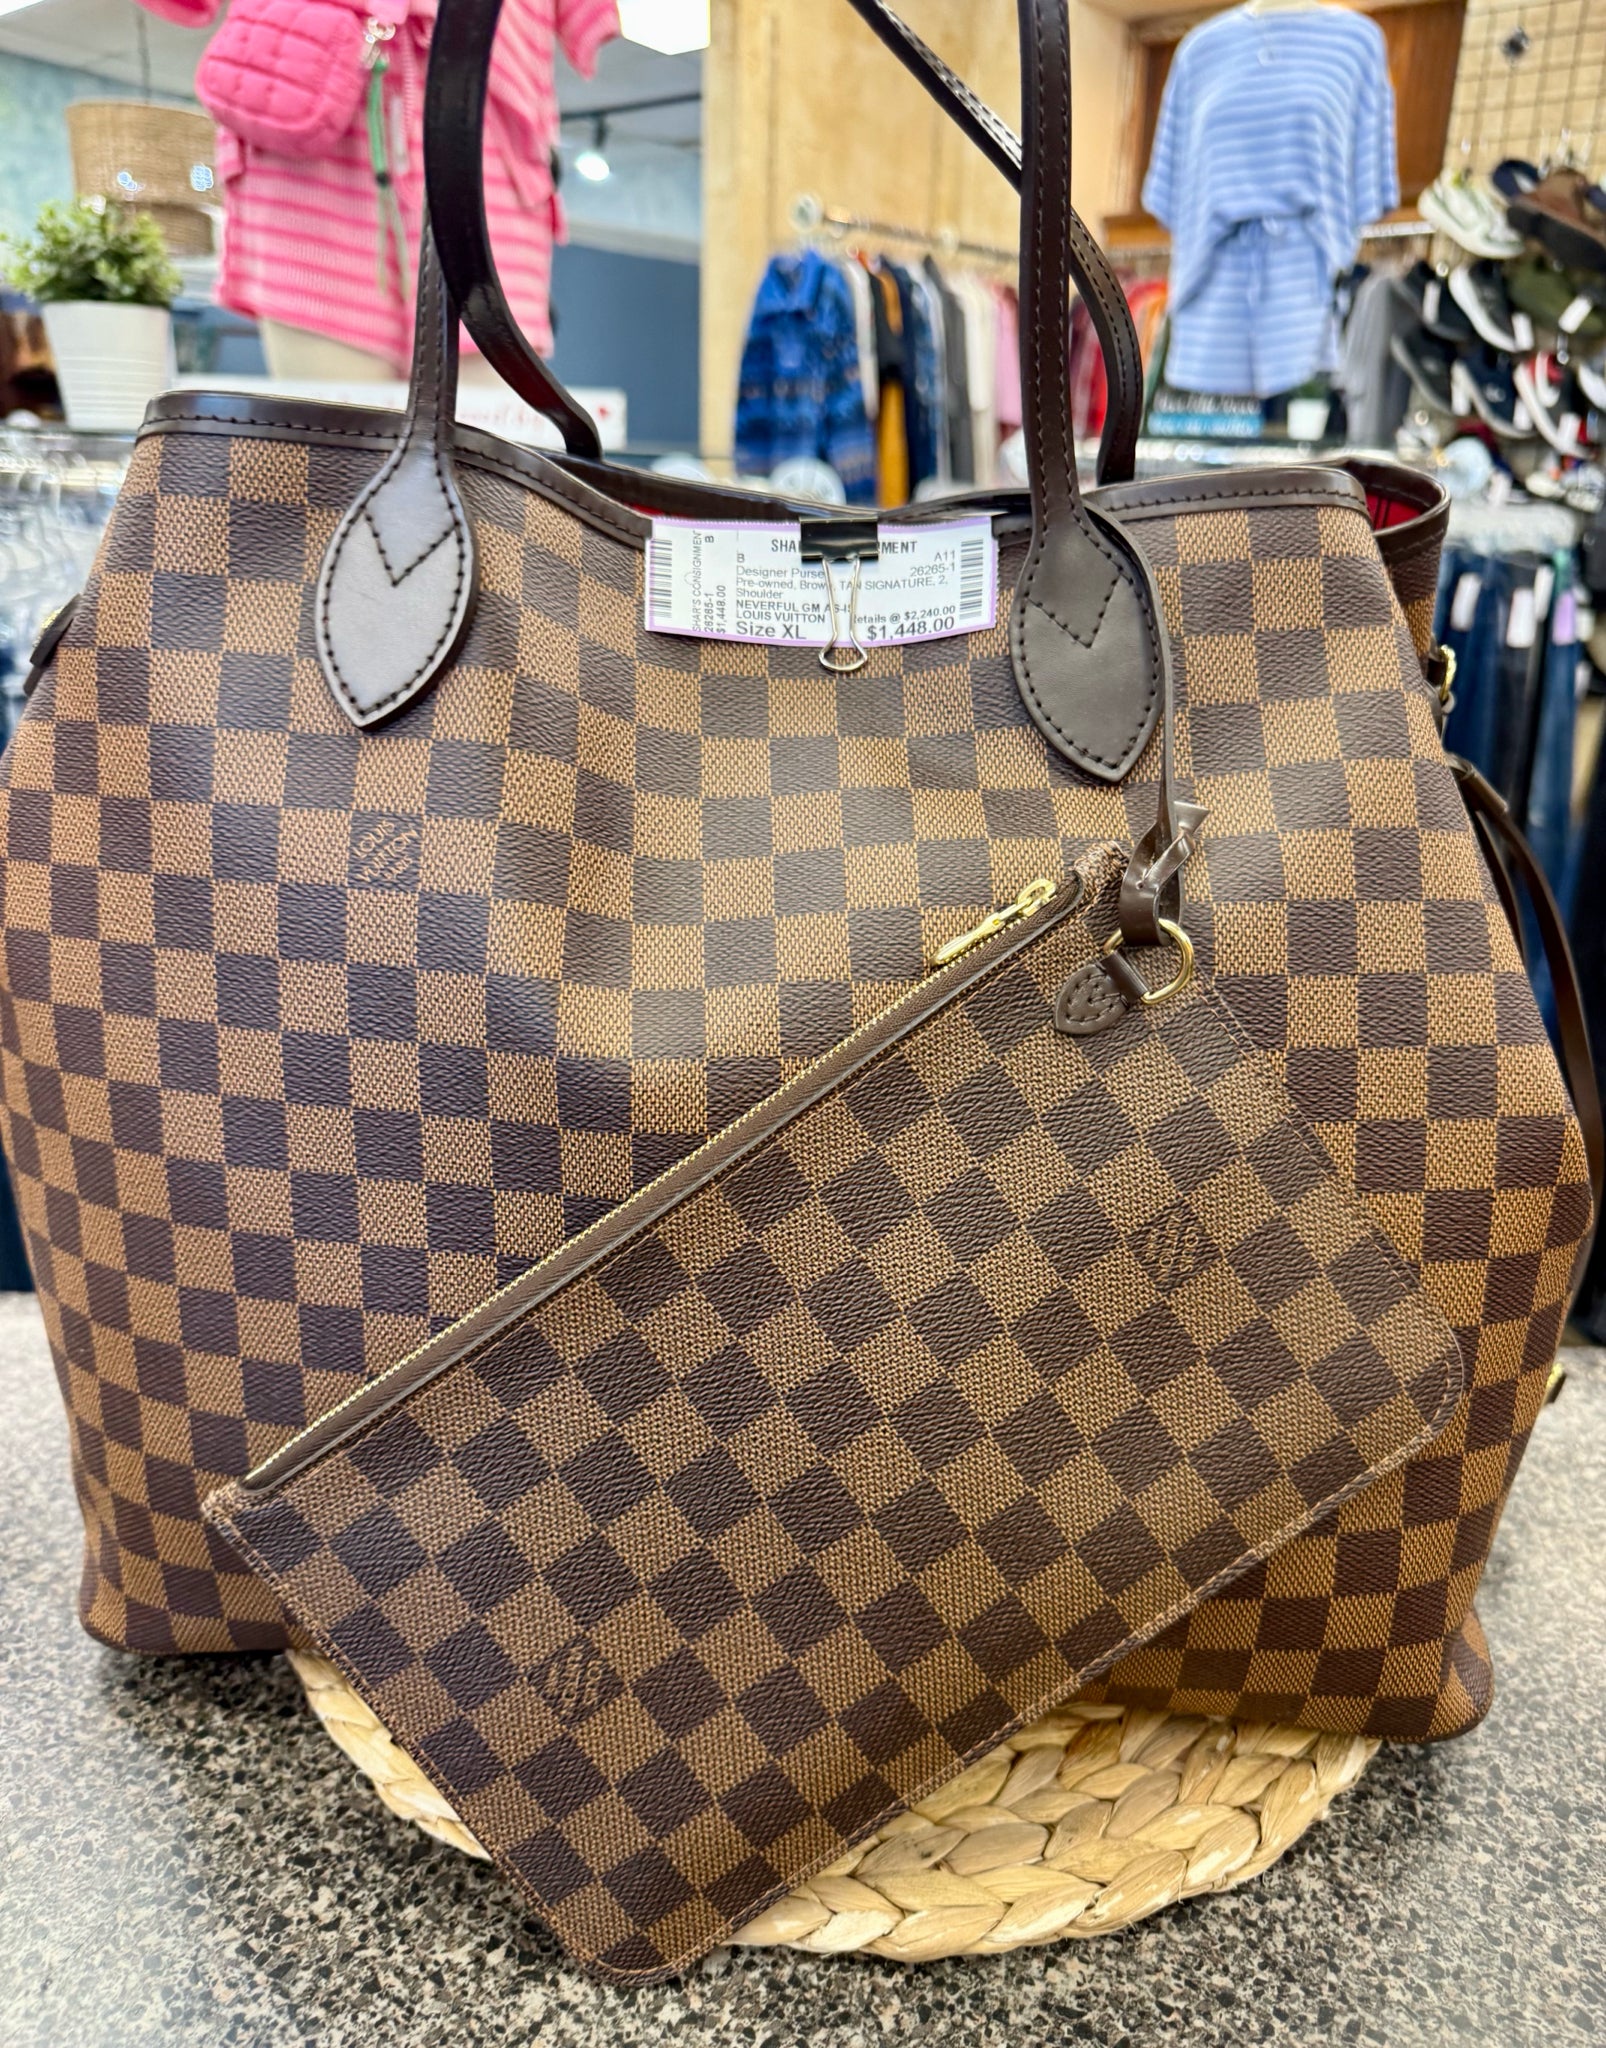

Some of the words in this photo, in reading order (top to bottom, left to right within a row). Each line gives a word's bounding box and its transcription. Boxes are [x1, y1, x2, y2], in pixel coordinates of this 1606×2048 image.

[704, 535, 714, 543] B
[771, 538, 801, 553] SHA
[736, 553, 745, 563] B
[934, 550, 956, 562] A11
[736, 565, 788, 579] Designer
[791, 567, 825, 579] Purse
[910, 562, 956, 577] 26265-1
[736, 577, 797, 590] Pre-owned,
[800, 580, 836, 591] Brow,
[865, 577, 936, 590] SIGNATURE,
[736, 588, 784, 599] Shoulder
[716, 585, 727, 634] $1,448.00
[736, 599, 799, 612] NEVERFUL
[802, 603, 820, 612] GM
[692, 599, 702, 632] SHAR'S
[736, 610, 771, 621] LOUIS
[774, 611, 826, 623] VUITTON
[889, 612, 901, 624] @
[904, 604, 956, 621] $2,240.00
[736, 620, 776, 638] Size
[782, 624, 807, 640] XL
[867, 616, 955, 641] $1,448.00
[352, 820, 395, 858] LOUIS
